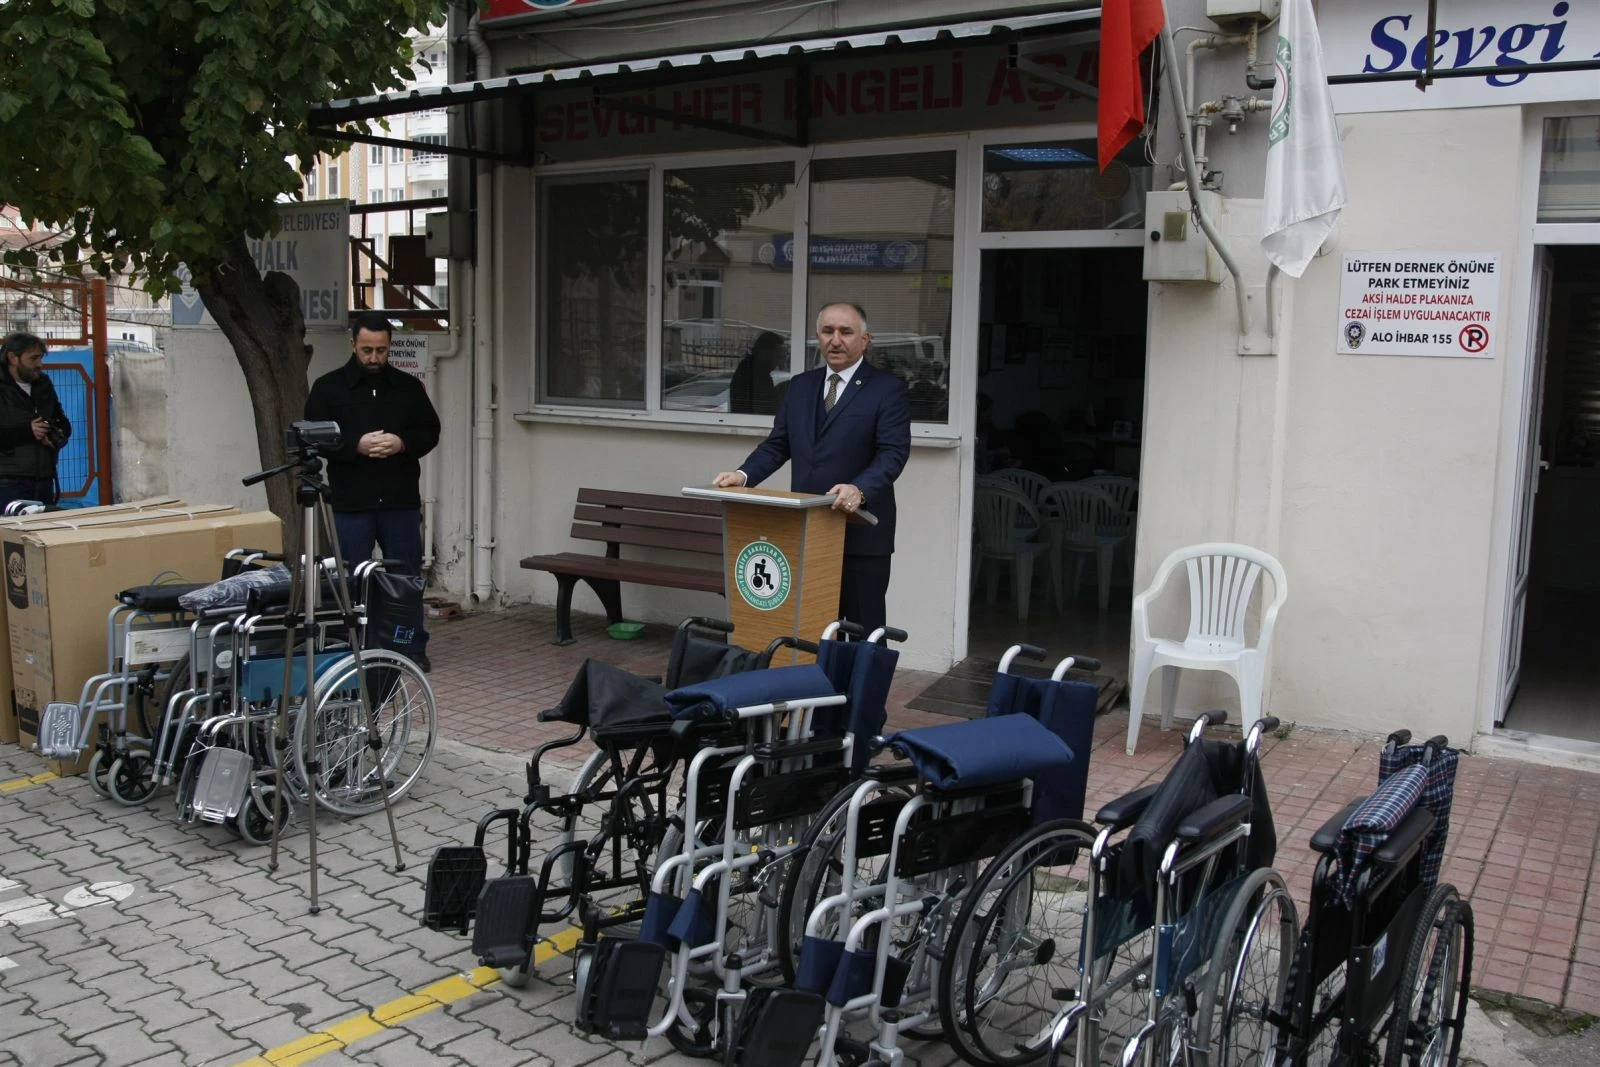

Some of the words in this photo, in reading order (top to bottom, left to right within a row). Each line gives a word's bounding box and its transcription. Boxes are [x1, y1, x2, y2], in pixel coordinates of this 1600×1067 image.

[1362, 1, 1569, 87] Sevgi
[537, 88, 656, 142] SEVGİ
[673, 83, 763, 131] HER
[784, 51, 964, 120] ENGELİ
[986, 50, 1099, 111] AŞA
[252, 240, 299, 270] HALK
[1347, 259, 1391, 273] LÜTFEN
[1394, 262, 1445, 273] DERNEK
[1447, 260, 1495, 273] ÖNÜNE
[1368, 278, 1400, 289] PARK
[1403, 275, 1470, 289] ETMEYİNİZ
[300, 280, 338, 320] NESİ
[1362, 291, 1384, 304] AKSİ
[1386, 294, 1417, 305] HALDE
[1419, 294, 1474, 305] PLAKANIZA
[1345, 306, 1372, 319] CEZAİ
[1374, 306, 1401, 322] İŞLEM
[1403, 310, 1491, 322] UYGULANACAKTIR
[406, 338, 426, 348] ÖNÜNE
[1371, 332, 1393, 343] ALO
[1395, 330, 1429, 344] İHBAR
[1432, 334, 1453, 344] 155
